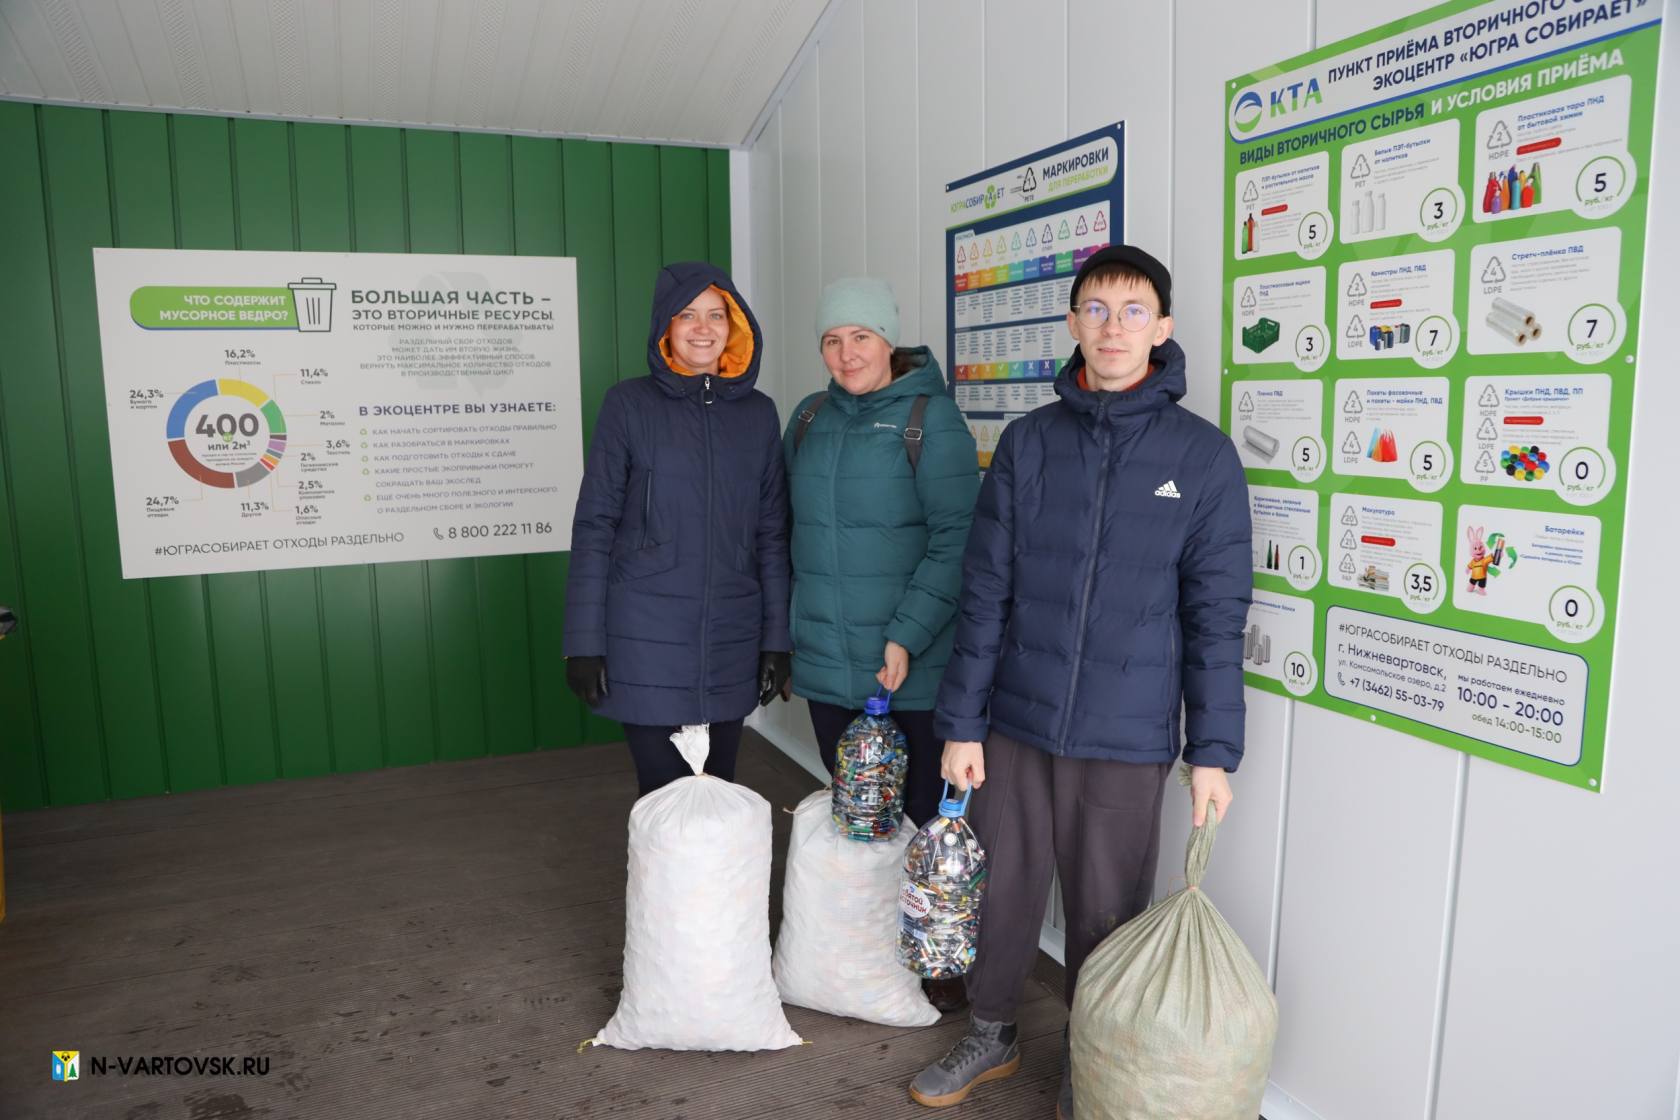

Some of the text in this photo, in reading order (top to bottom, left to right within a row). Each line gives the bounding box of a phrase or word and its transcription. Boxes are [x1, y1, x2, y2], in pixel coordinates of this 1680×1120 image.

[1328, 57, 1373, 83] ПУНКТ
[1377, 35, 1439, 68] ПРИЁМА
[1373, 54, 1454, 90] ЭКОЦЕНТР
[1460, 34, 1519, 63] «ЮГРА
[1240, 49, 1624, 165] ВИДЫ ВТОРИЧНОГО СЫРЬЯ И УСЛОВИЯ ПРИЁМА
[1587, 96, 1605, 105] ПНД
[1489, 150, 1509, 160] HDPE
[1043, 147, 1108, 180] МАРКИРОВКИ
[1594, 173, 1607, 192] 5
[1434, 202, 1443, 219] 3
[1309, 225, 1316, 239] 5
[1484, 286, 1502, 294] LDPE
[184, 295, 286, 307] ЧТО СОДЕРЖИТ
[352, 290, 459, 304] БОЛЬШАЯ
[466, 291, 534, 305] ЧАСТЬ
[160, 310, 288, 321] МУСОРНОЕ ВЕДРО?
[353, 310, 382, 320] ЭТО
[388, 310, 480, 320] ВТОРИЧНЫЕ
[1586, 320, 1598, 338] 7
[1306, 338, 1313, 352] 3
[1429, 331, 1438, 346] 7
[225, 350, 255, 359] 16,2%
[300, 369, 328, 378] 11,4%
[130, 390, 164, 399] 24,3%
[320, 410, 335, 419] 2%
[360, 402, 556, 417] В ЭКОЦЕНТРЕ ВЫ УЗНАЕТЕ:
[196, 413, 259, 438] 400
[423, 426, 477, 434] СОРТИРОВАТЬ
[326, 440, 350, 449] 3,6%
[391, 440, 445, 448] РАЗОБРАТЬСЯ
[301, 453, 316, 462] 2%
[1303, 448, 1310, 462] 5
[442, 464, 497, 472] ЭКОПРИВЫЧКИ
[1423, 455, 1433, 471] 5
[1576, 462, 1589, 480] 0
[298, 480, 323, 490] 2,5%
[376, 480, 423, 488] СОКРАЩАТЬ
[146, 496, 179, 506] 24,7%
[1155, 489, 1181, 499] adidas
[241, 502, 269, 512] 11,3%
[296, 506, 318, 515] 1,6%
[386, 506, 437, 514] РАЗДЕЛЬНОМ
[449, 522, 552, 538] 8 800 222 11 86
[155, 532, 404, 556] #ЮГРАСОБИРАЕТ ОТХОДЫ РАЗДЕЛЬНО
[1300, 557, 1304, 570] 1
[1411, 574, 1432, 593] 3,5
[1566, 599, 1578, 617] 0
[1339, 624, 1568, 683] #ЮГРАСОБИРАЕТ ОТХОДЫ РАЗДЕЛЬНО
[1339, 644, 1447, 680] г. Нижневартовск,
[1291, 663, 1305, 678] 10
[1338, 660, 1348, 668] ул.
[1350, 660, 1406, 682] Комсомольское
[1408, 675, 1432, 689] озеро,
[1350, 678, 1444, 712] +7 (3462) 55-03-79
[1471, 676, 1513, 694] работаем
[1515, 688, 1565, 706] ежедневно
[1457, 687, 1497, 709] 10:00
[1515, 702, 1564, 726] 20:00
[1472, 714, 1562, 744] обед 14:00-15:00
